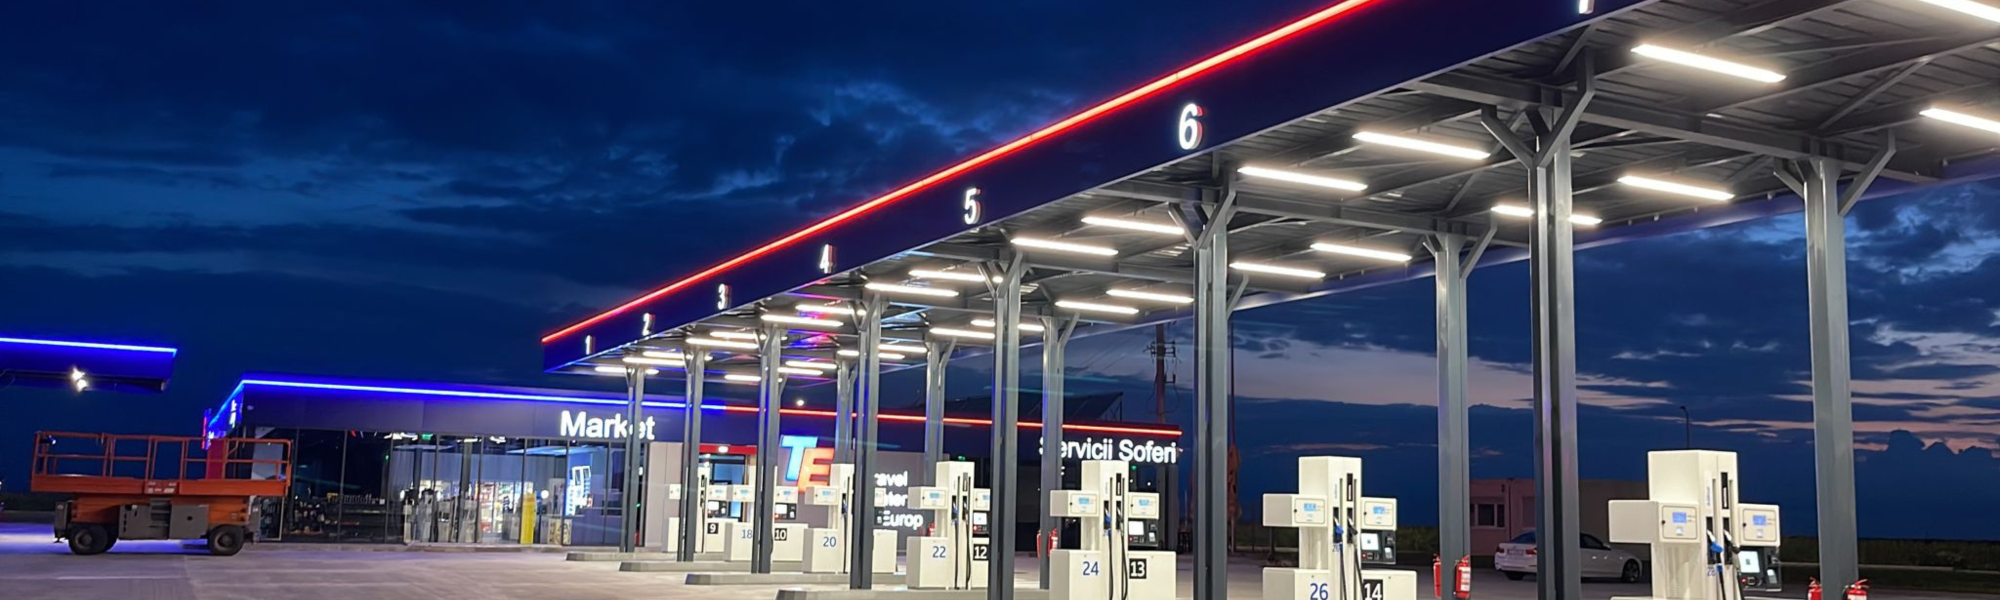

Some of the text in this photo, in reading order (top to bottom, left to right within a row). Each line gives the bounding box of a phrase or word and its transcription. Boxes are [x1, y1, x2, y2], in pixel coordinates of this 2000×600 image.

[1179, 102, 1201, 150] 6
[963, 187, 980, 225] 5
[819, 243, 833, 274] 4
[717, 283, 730, 310] 3
[642, 312, 653, 336] 2
[585, 334, 593, 355] 1
[560, 409, 656, 441] Market
[1118, 438, 1177, 464] Soferi
[780, 434, 836, 493] TE
[709, 523, 717, 533] 9
[741, 529, 753, 539] 18
[774, 529, 787, 540] 10
[822, 536, 837, 548] 20
[932, 545, 946, 558] 22
[974, 545, 988, 559] 12
[1082, 560, 1099, 576] 24
[1130, 560, 1146, 577] 13
[1309, 582, 1329, 600] 26
[1364, 582, 1383, 600] 14
